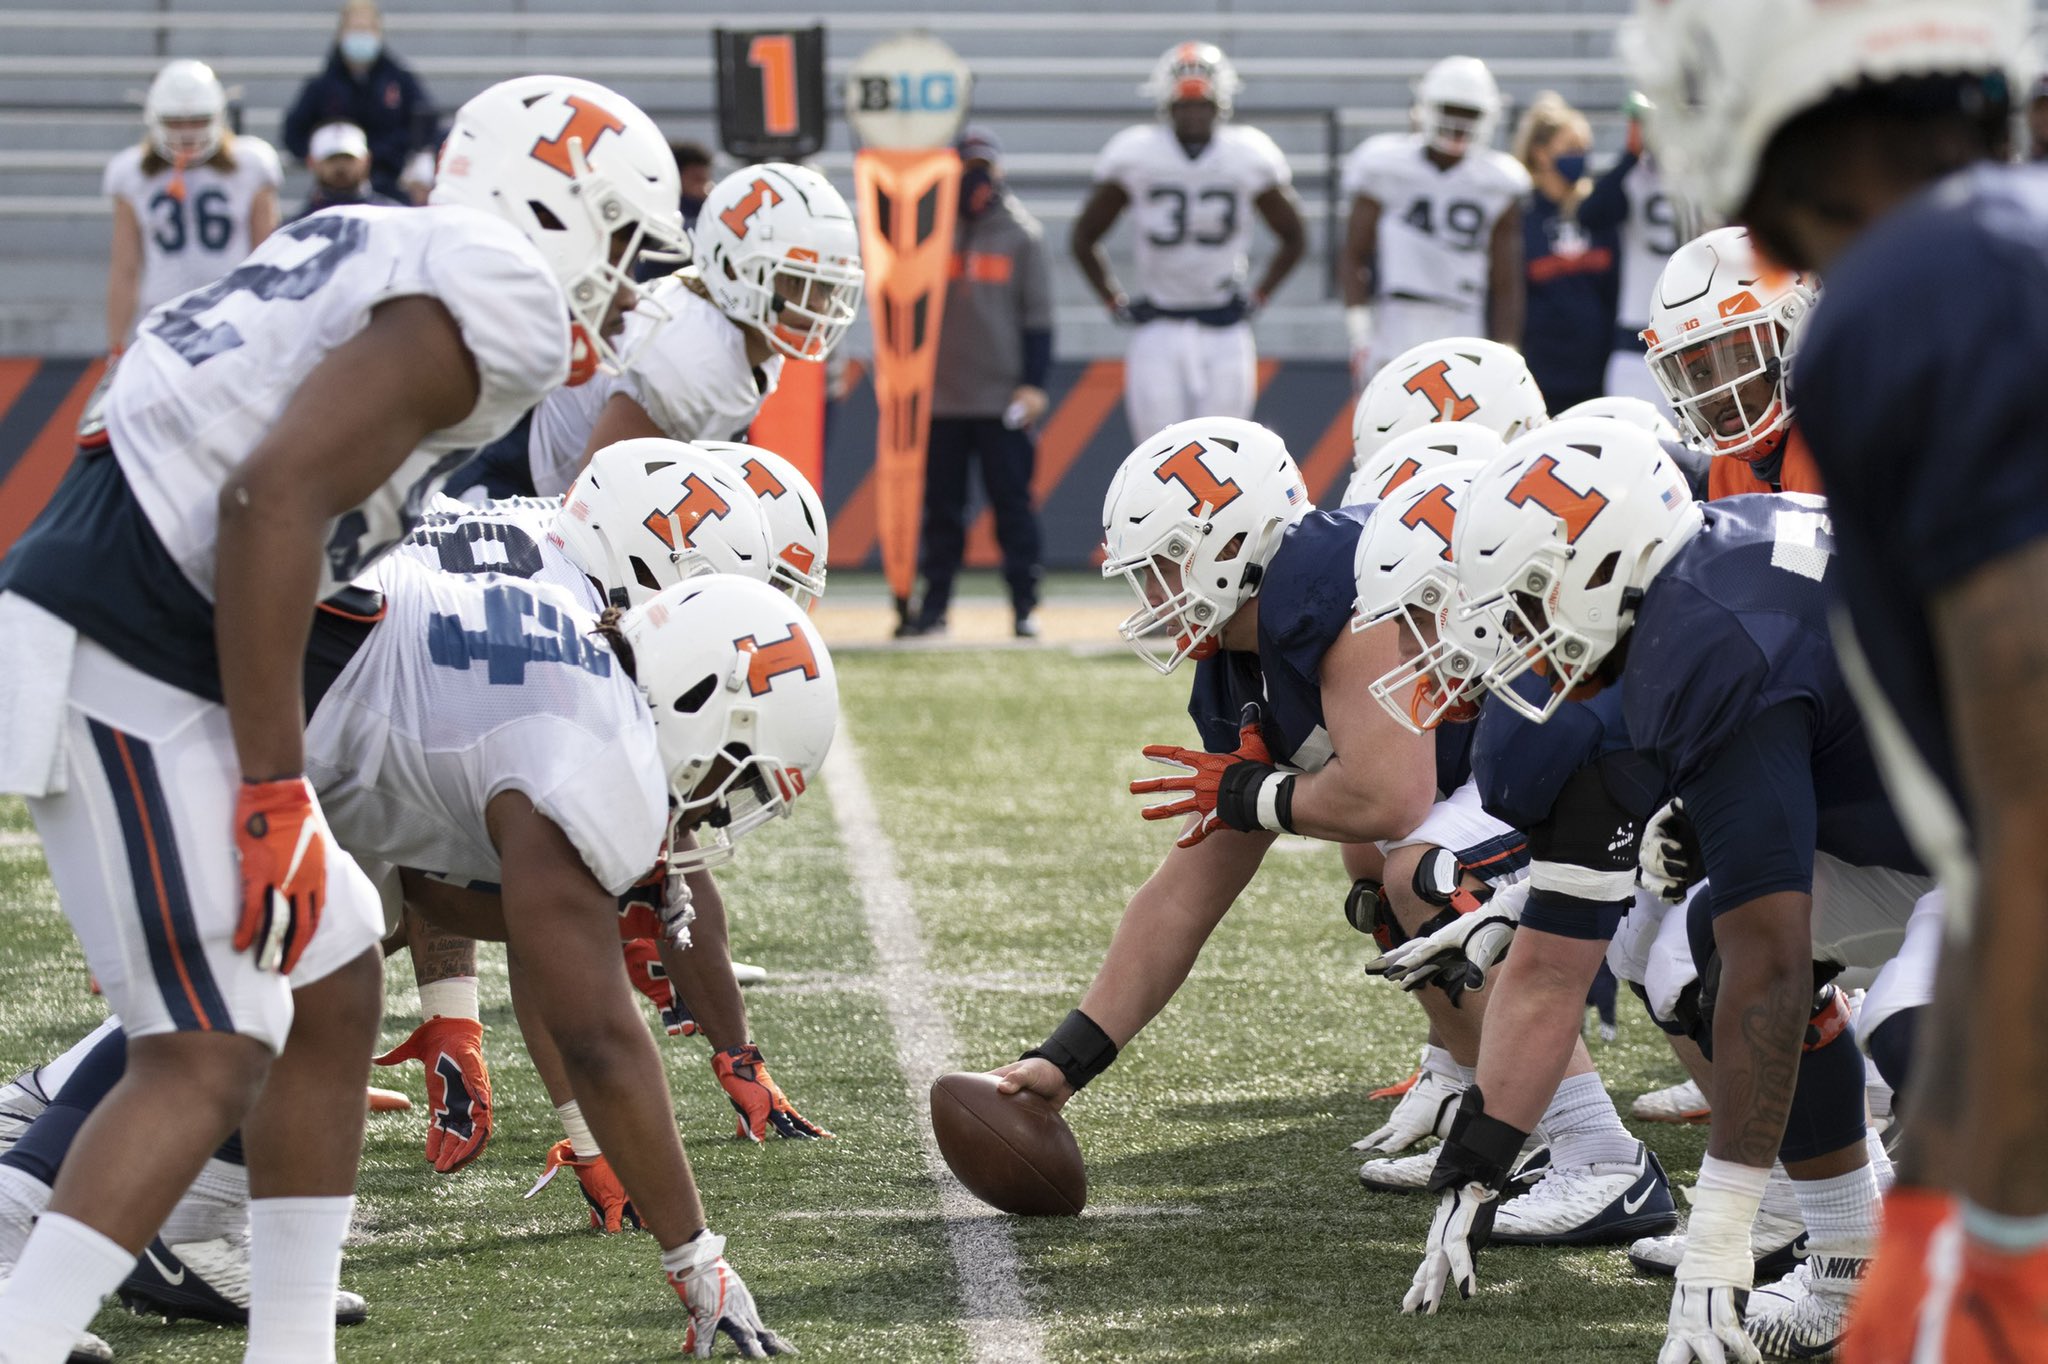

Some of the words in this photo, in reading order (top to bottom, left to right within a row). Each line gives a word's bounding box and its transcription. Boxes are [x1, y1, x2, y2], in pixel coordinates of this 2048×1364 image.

[748, 35, 799, 136] 1
[529, 95, 627, 179] I
[150, 187, 232, 253] 36
[719, 178, 784, 240] I
[1147, 187, 1237, 247] 33
[1404, 198, 1484, 250] 49
[1403, 360, 1480, 423] I
[643, 472, 731, 551] I
[1153, 440, 1243, 519] I
[1505, 453, 1610, 545] I
[428, 584, 611, 685] 4
[732, 622, 820, 697] I
[1824, 1257, 1872, 1279] NIKE
